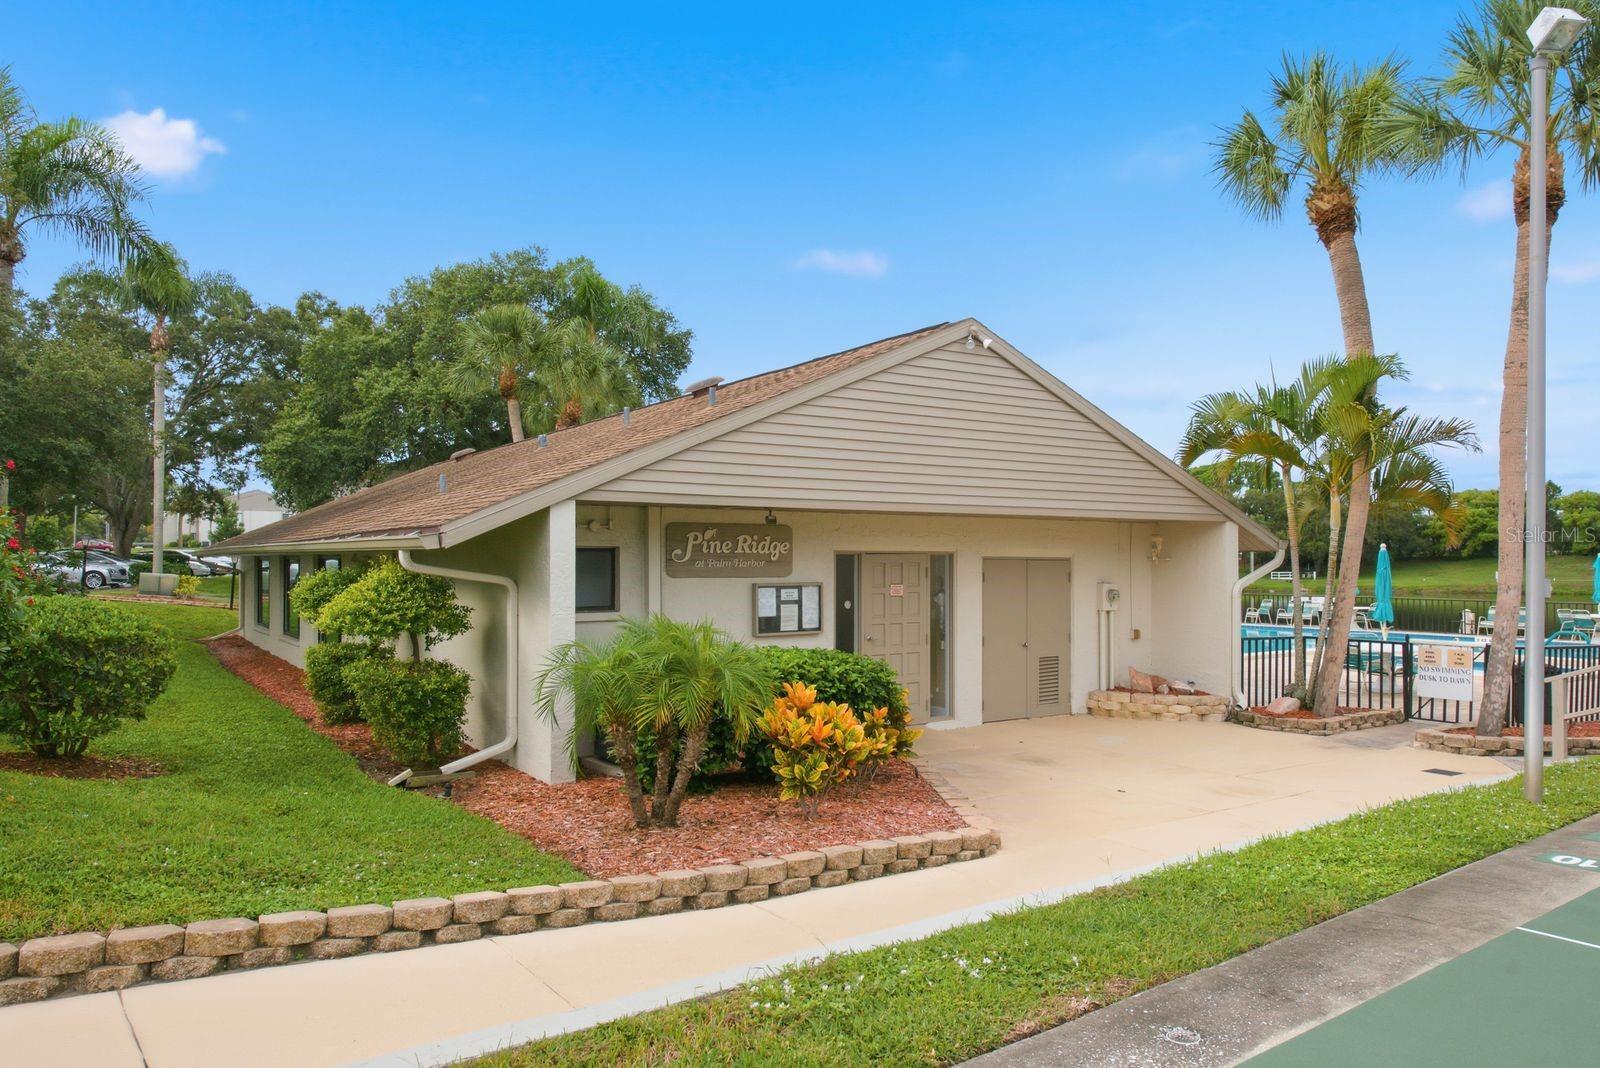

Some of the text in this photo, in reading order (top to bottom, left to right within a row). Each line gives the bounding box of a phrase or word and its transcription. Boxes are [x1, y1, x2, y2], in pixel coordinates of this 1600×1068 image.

[671, 529, 790, 563] Pine Ridge
[695, 559, 766, 568] at Palm Harbor
[1419, 665, 1471, 676] NO SWIMMING
[1419, 674, 1471, 685] DUSK TO DAWN
